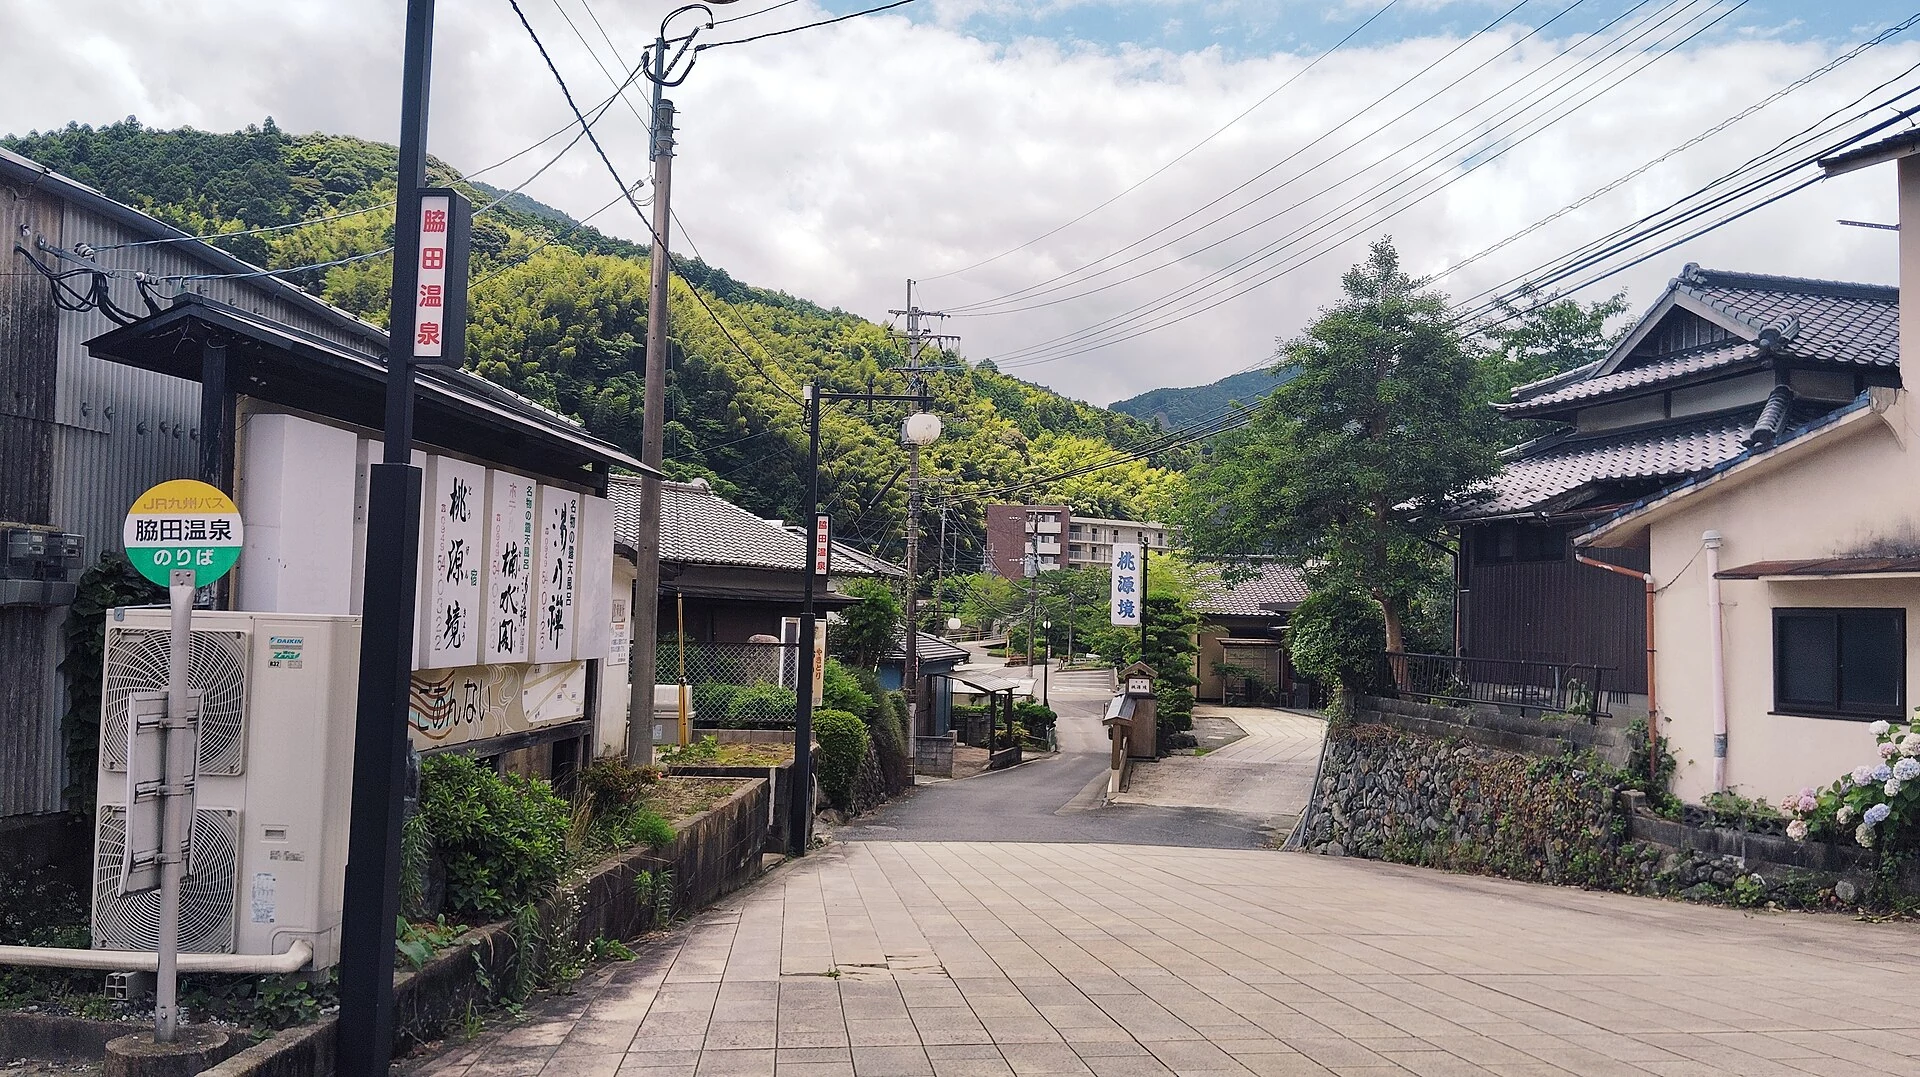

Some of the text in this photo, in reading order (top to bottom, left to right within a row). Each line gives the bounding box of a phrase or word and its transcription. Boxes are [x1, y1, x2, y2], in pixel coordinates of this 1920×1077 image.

[417, 210, 445, 346] 脇田温泉
[143, 497, 225, 510] JR九州バス
[135, 519, 232, 541] 脇田温泉
[817, 520, 827, 570] 脇田温泉
[153, 549, 214, 566] のりば
[444, 477, 467, 649] 桃源境
[1116, 551, 1136, 619] 桃源境
[417, 679, 491, 731] ごあんない
